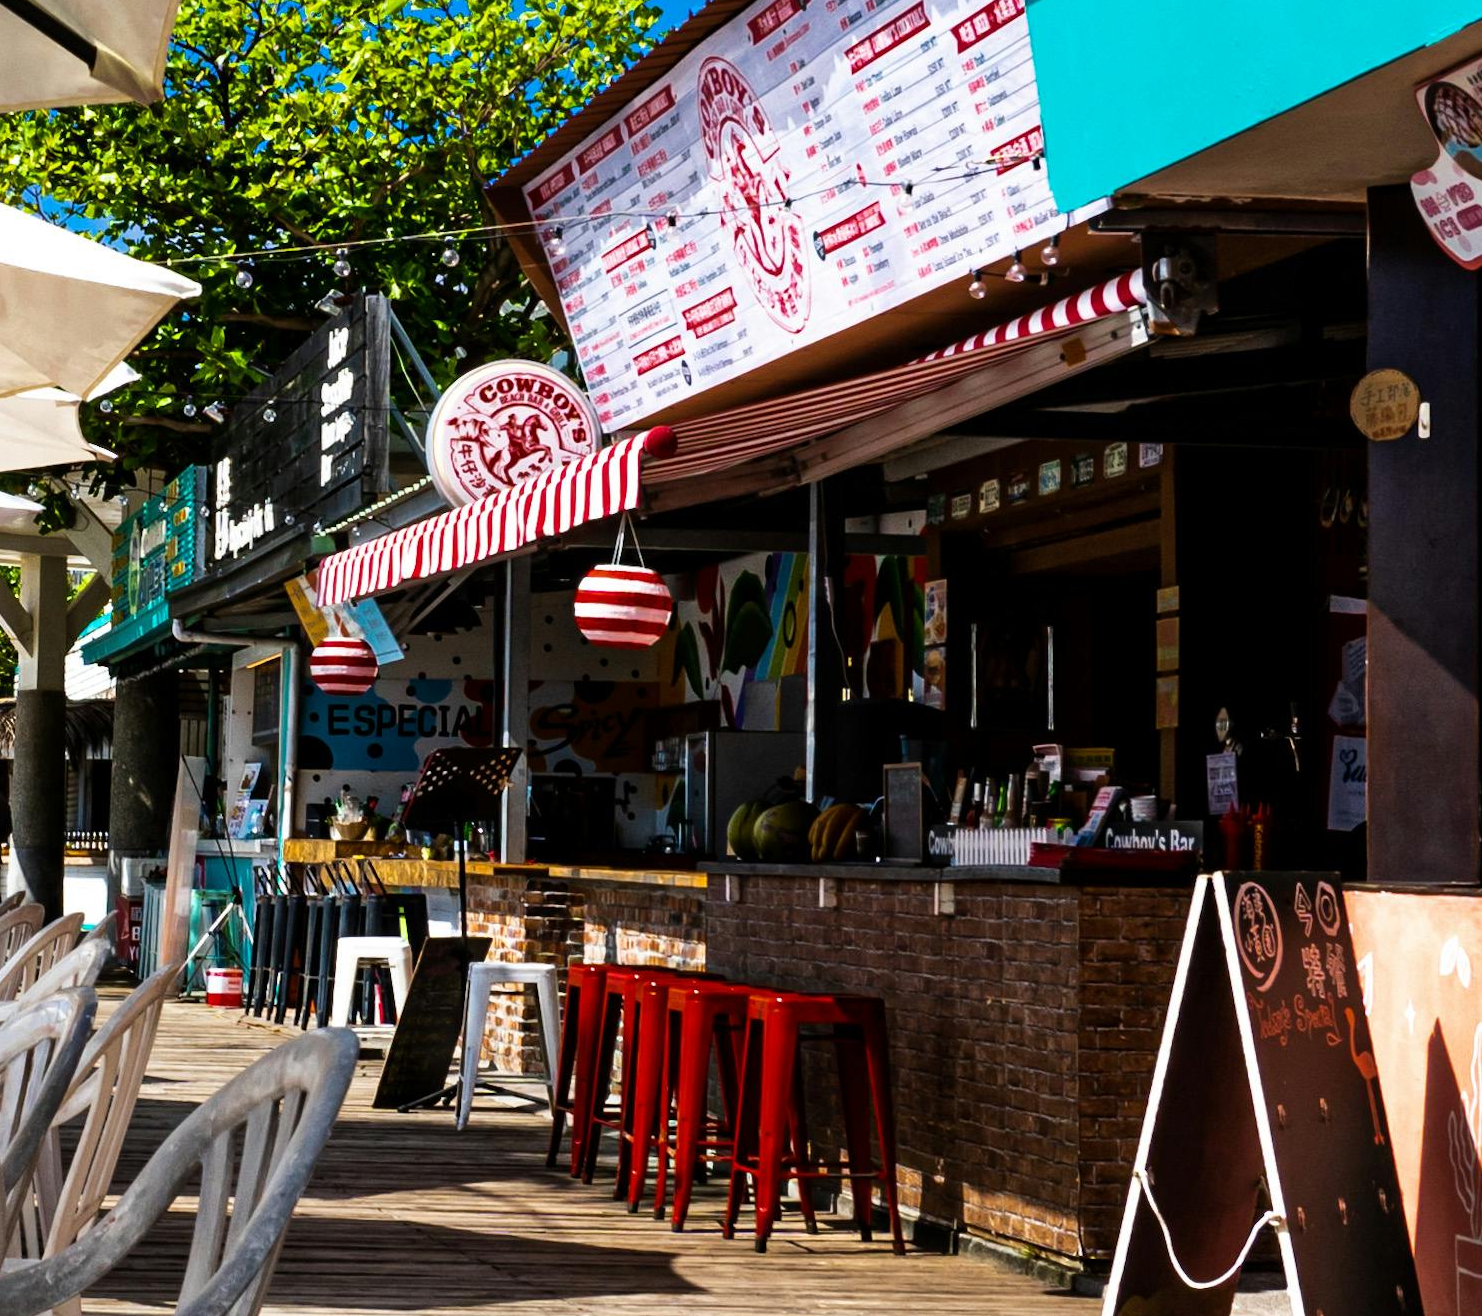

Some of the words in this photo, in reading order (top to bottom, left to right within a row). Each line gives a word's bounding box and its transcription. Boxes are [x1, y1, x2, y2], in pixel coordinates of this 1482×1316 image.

[479, 378, 587, 443] COWBOY'S
[499, 393, 525, 405] BEACH
[527, 394, 543, 408] BAR
[549, 407, 568, 431] GRILL
[327, 704, 491, 738] ESPECIAL
[1170, 830, 1195, 851] Bar
